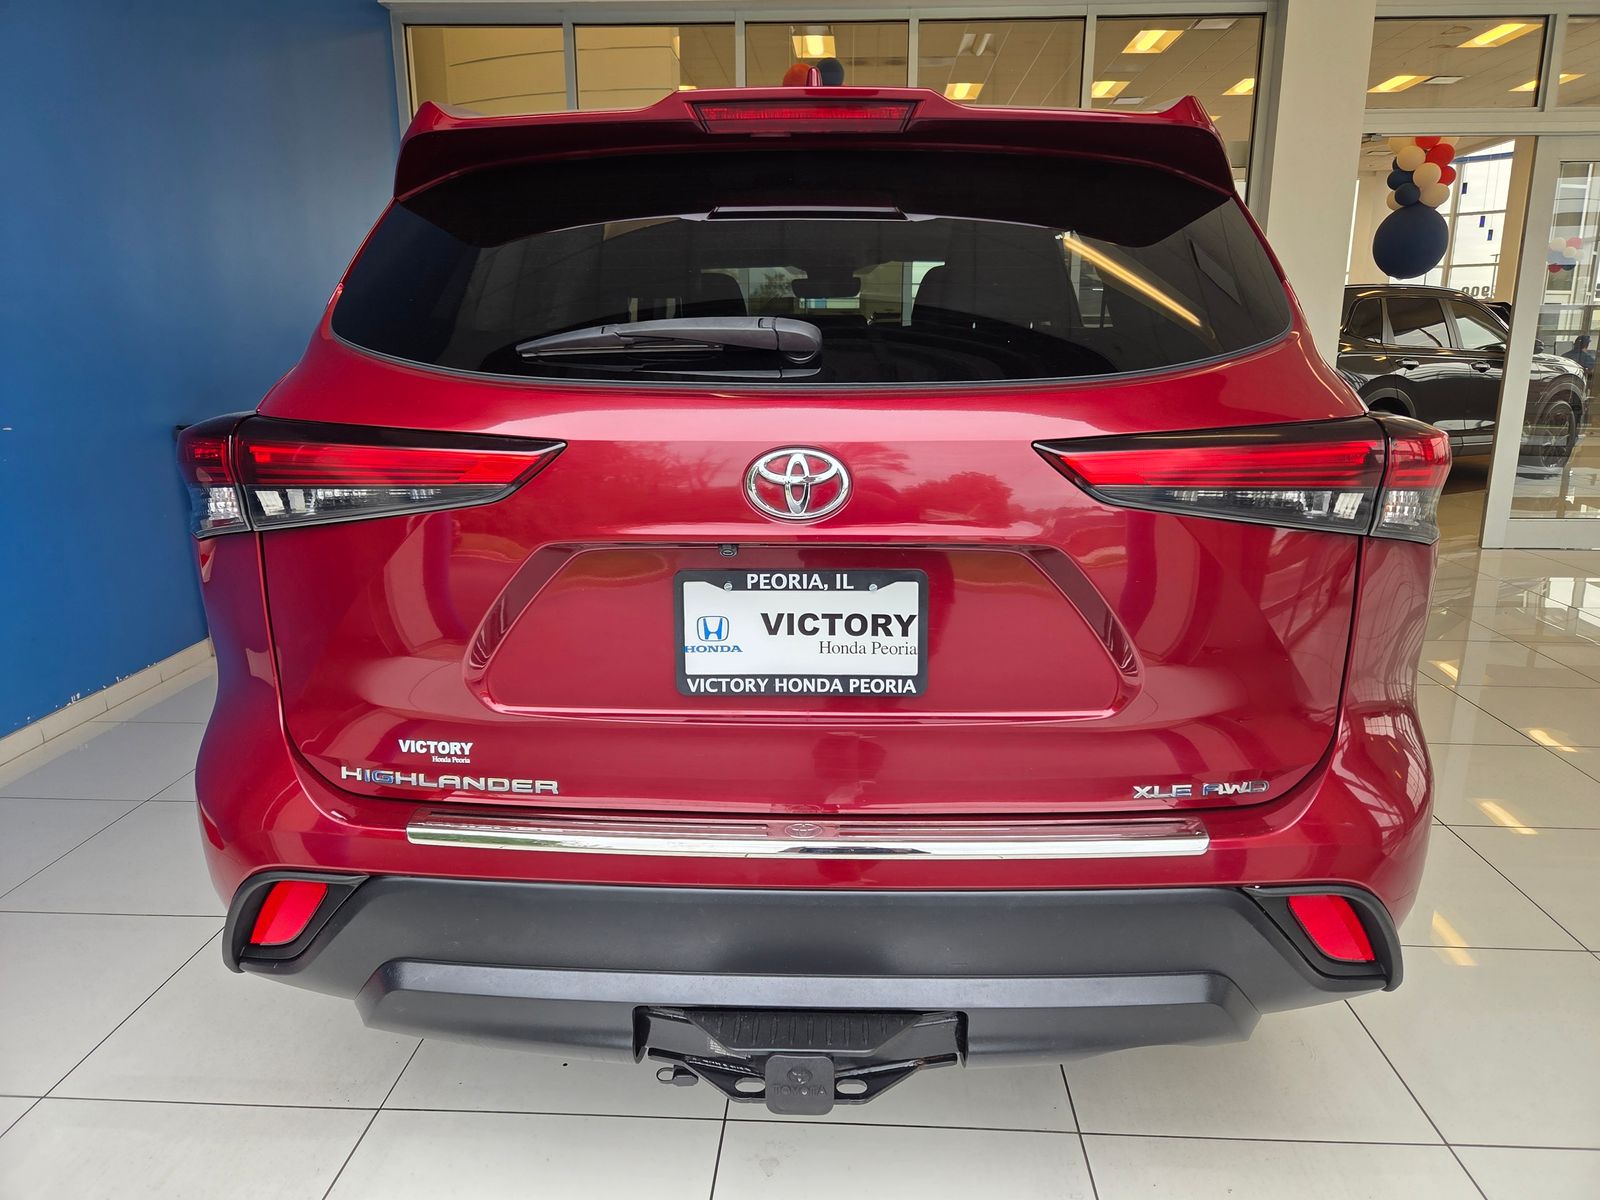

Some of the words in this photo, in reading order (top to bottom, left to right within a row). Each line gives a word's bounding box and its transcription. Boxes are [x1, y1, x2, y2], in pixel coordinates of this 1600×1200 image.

[746, 573, 829, 591] PEORIA,
[836, 573, 854, 590] IL
[760, 612, 917, 637] VICTORY
[682, 645, 743, 653] HONDA
[819, 641, 866, 655] Honda
[871, 641, 917, 655] Peoria
[686, 678, 769, 693] VICTORY
[775, 678, 843, 694] HONDA
[849, 678, 917, 694] PEORIA
[398, 739, 473, 755] VICTORY
[341, 766, 559, 794] HIGHLANDER
[1133, 784, 1192, 799] XLE
[1203, 780, 1269, 796] AWD
[772, 1085, 827, 1097] TOYOTA
